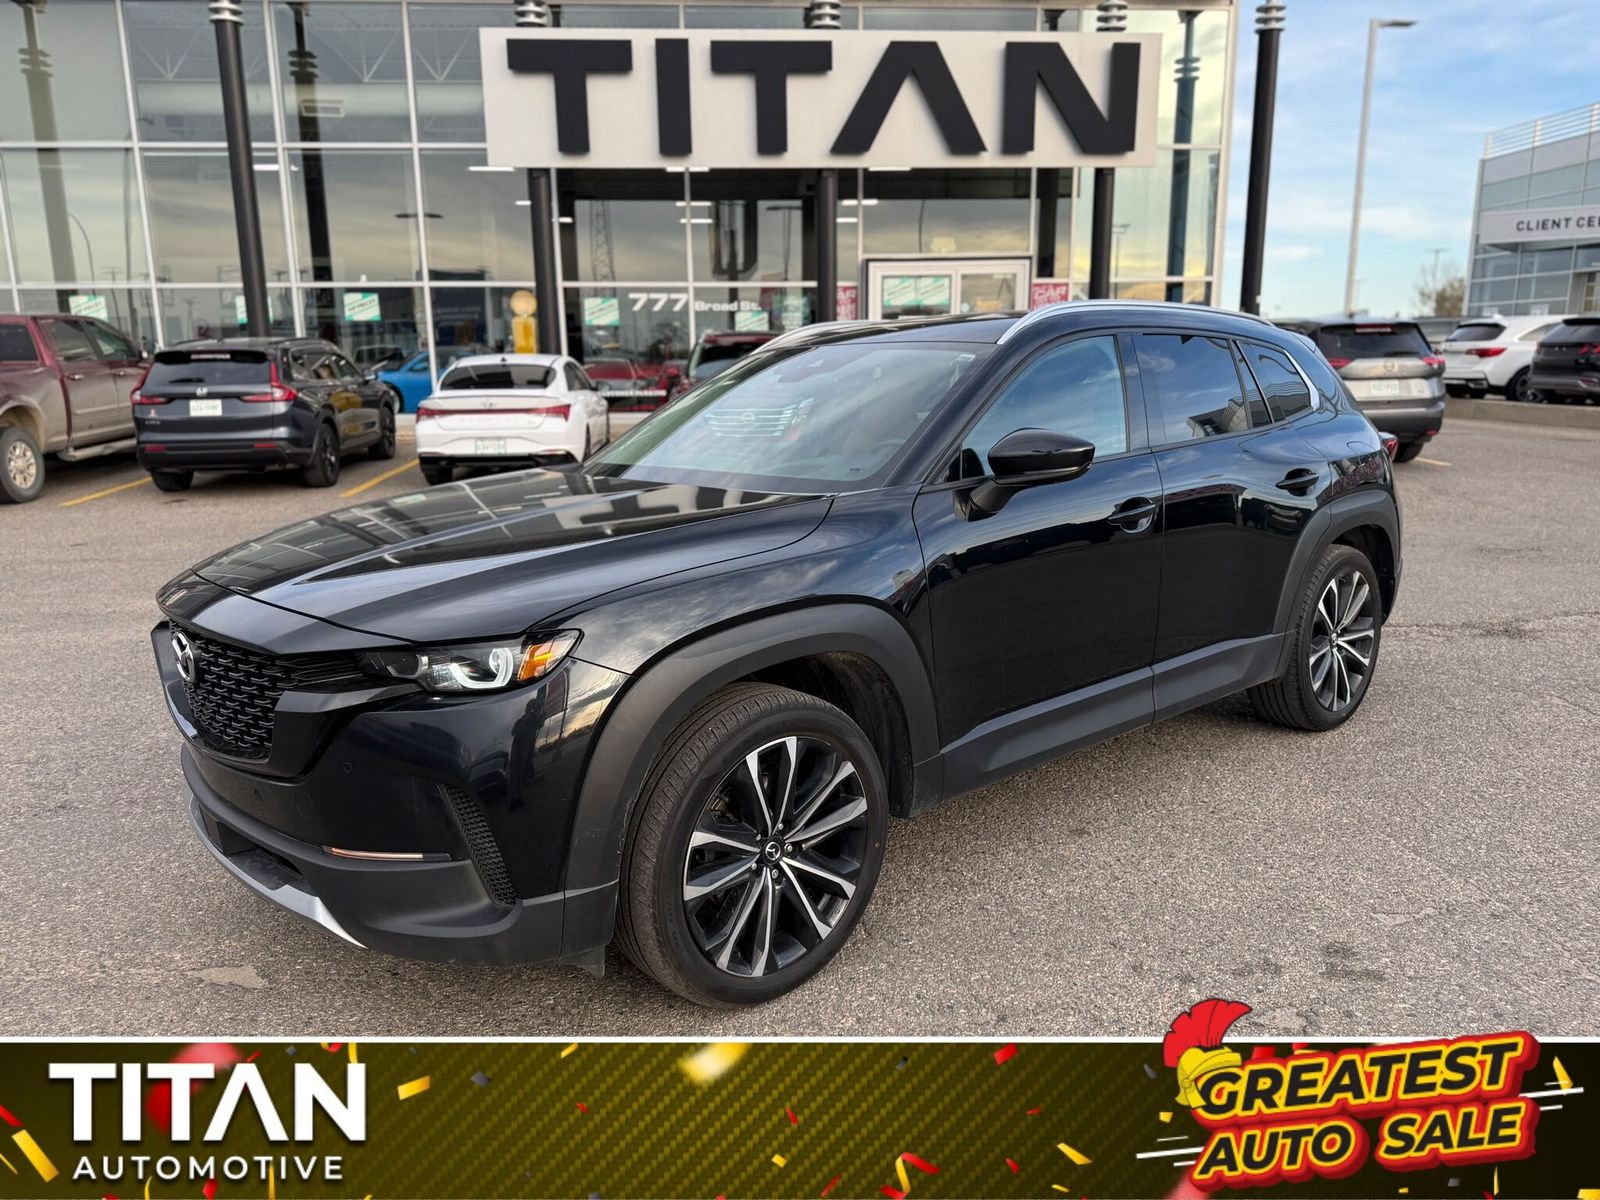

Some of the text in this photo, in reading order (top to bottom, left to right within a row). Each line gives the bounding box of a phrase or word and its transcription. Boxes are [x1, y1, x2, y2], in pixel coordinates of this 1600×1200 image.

[506, 37, 1141, 156] TITAN
[1516, 217, 1572, 232] CLIENT
[628, 292, 689, 312] 777
[694, 301, 738, 312] Broad
[740, 301, 762, 312] St.
